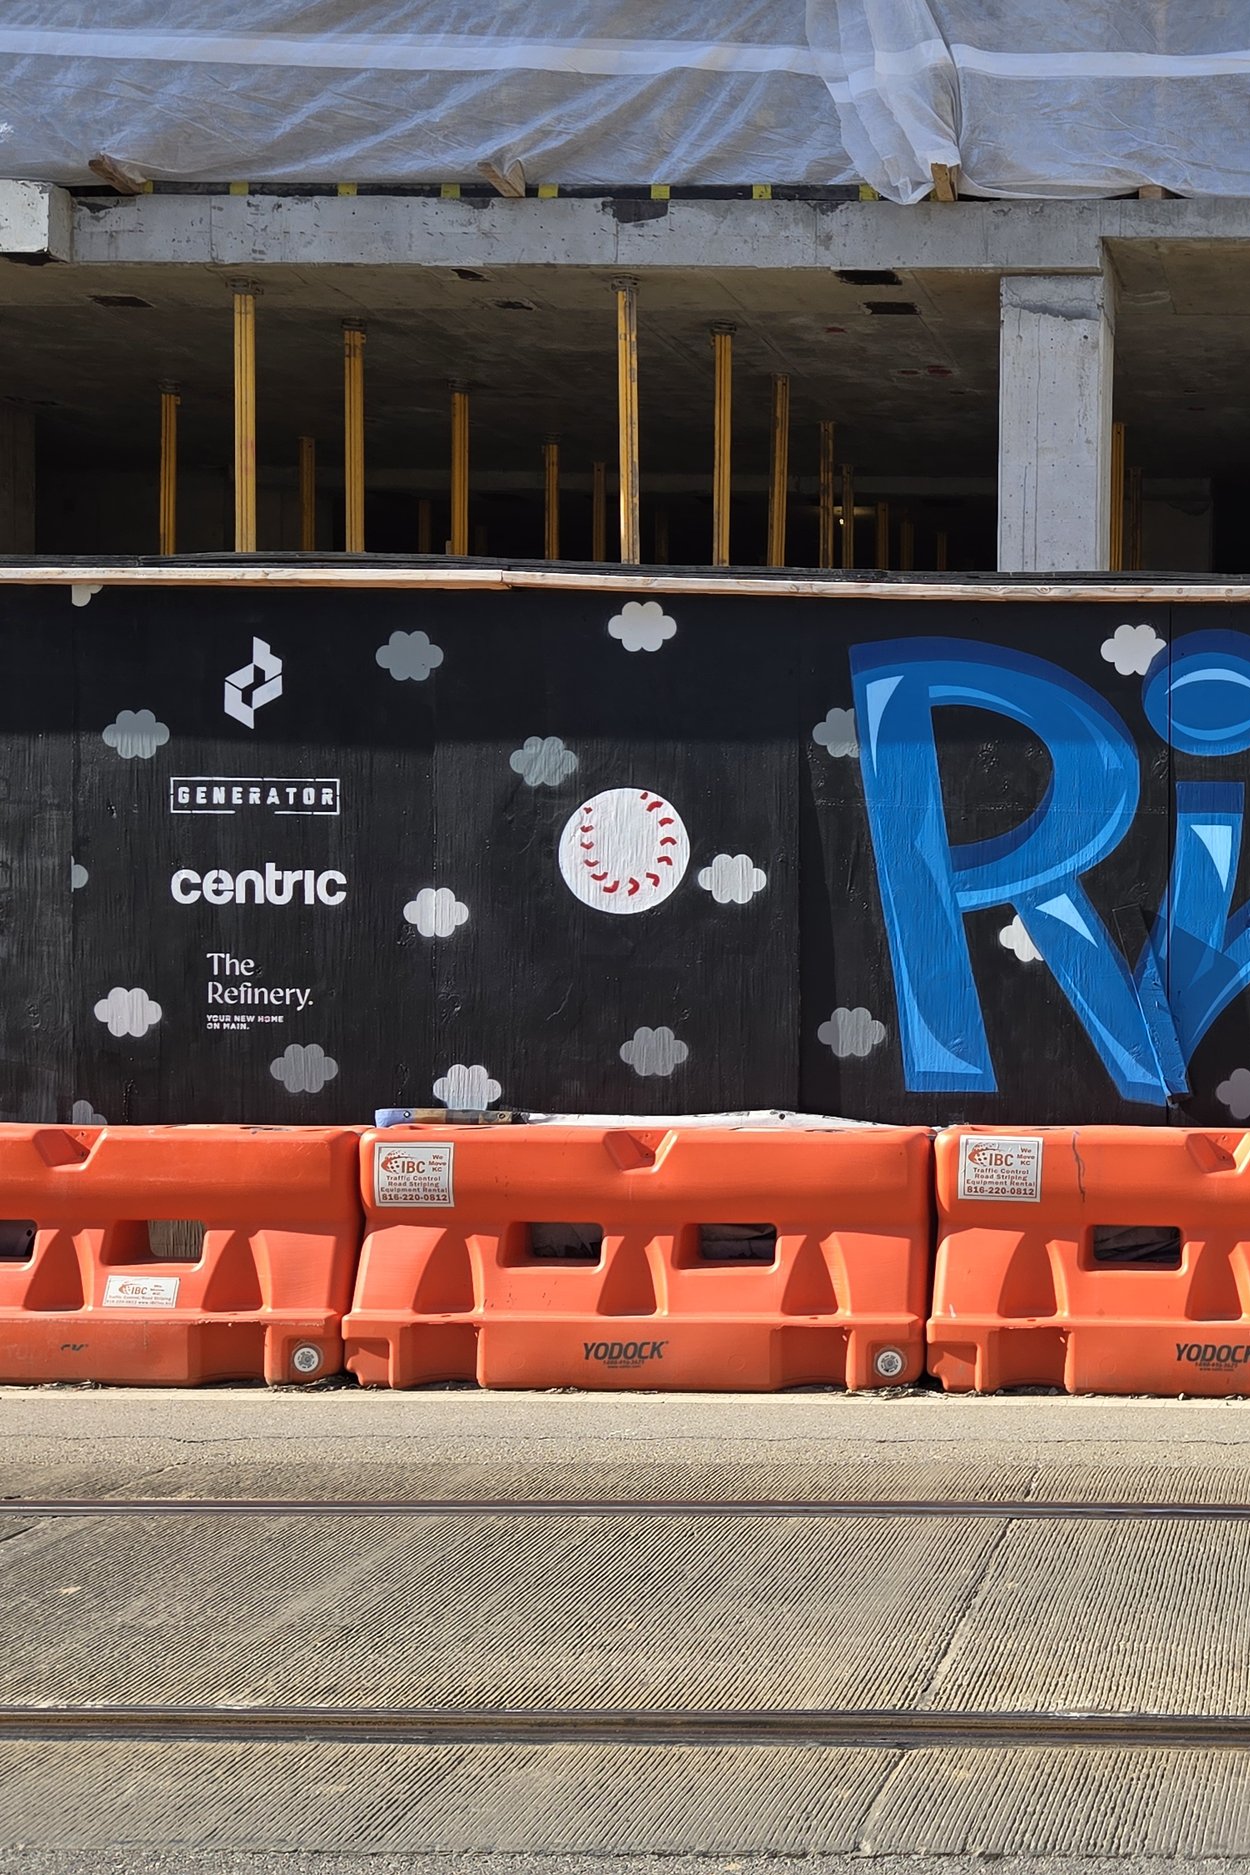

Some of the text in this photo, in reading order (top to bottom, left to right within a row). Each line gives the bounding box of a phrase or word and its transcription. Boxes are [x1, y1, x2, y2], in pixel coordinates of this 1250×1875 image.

[177, 786, 334, 806] GENERATOR
[171, 862, 347, 906] centric
[206, 953, 255, 976] The
[208, 981, 313, 1011] Refinery.
[206, 1015, 284, 1023] YOUR NEW HOME
[206, 1022, 250, 1030] ON MAIN.
[401, 1160, 425, 1174] IBC
[989, 1153, 1014, 1167] IBC
[966, 1186, 1035, 1196] 816-220-0812
[131, 1286, 148, 1295] IBC
[583, 1341, 666, 1360] YODOCK
